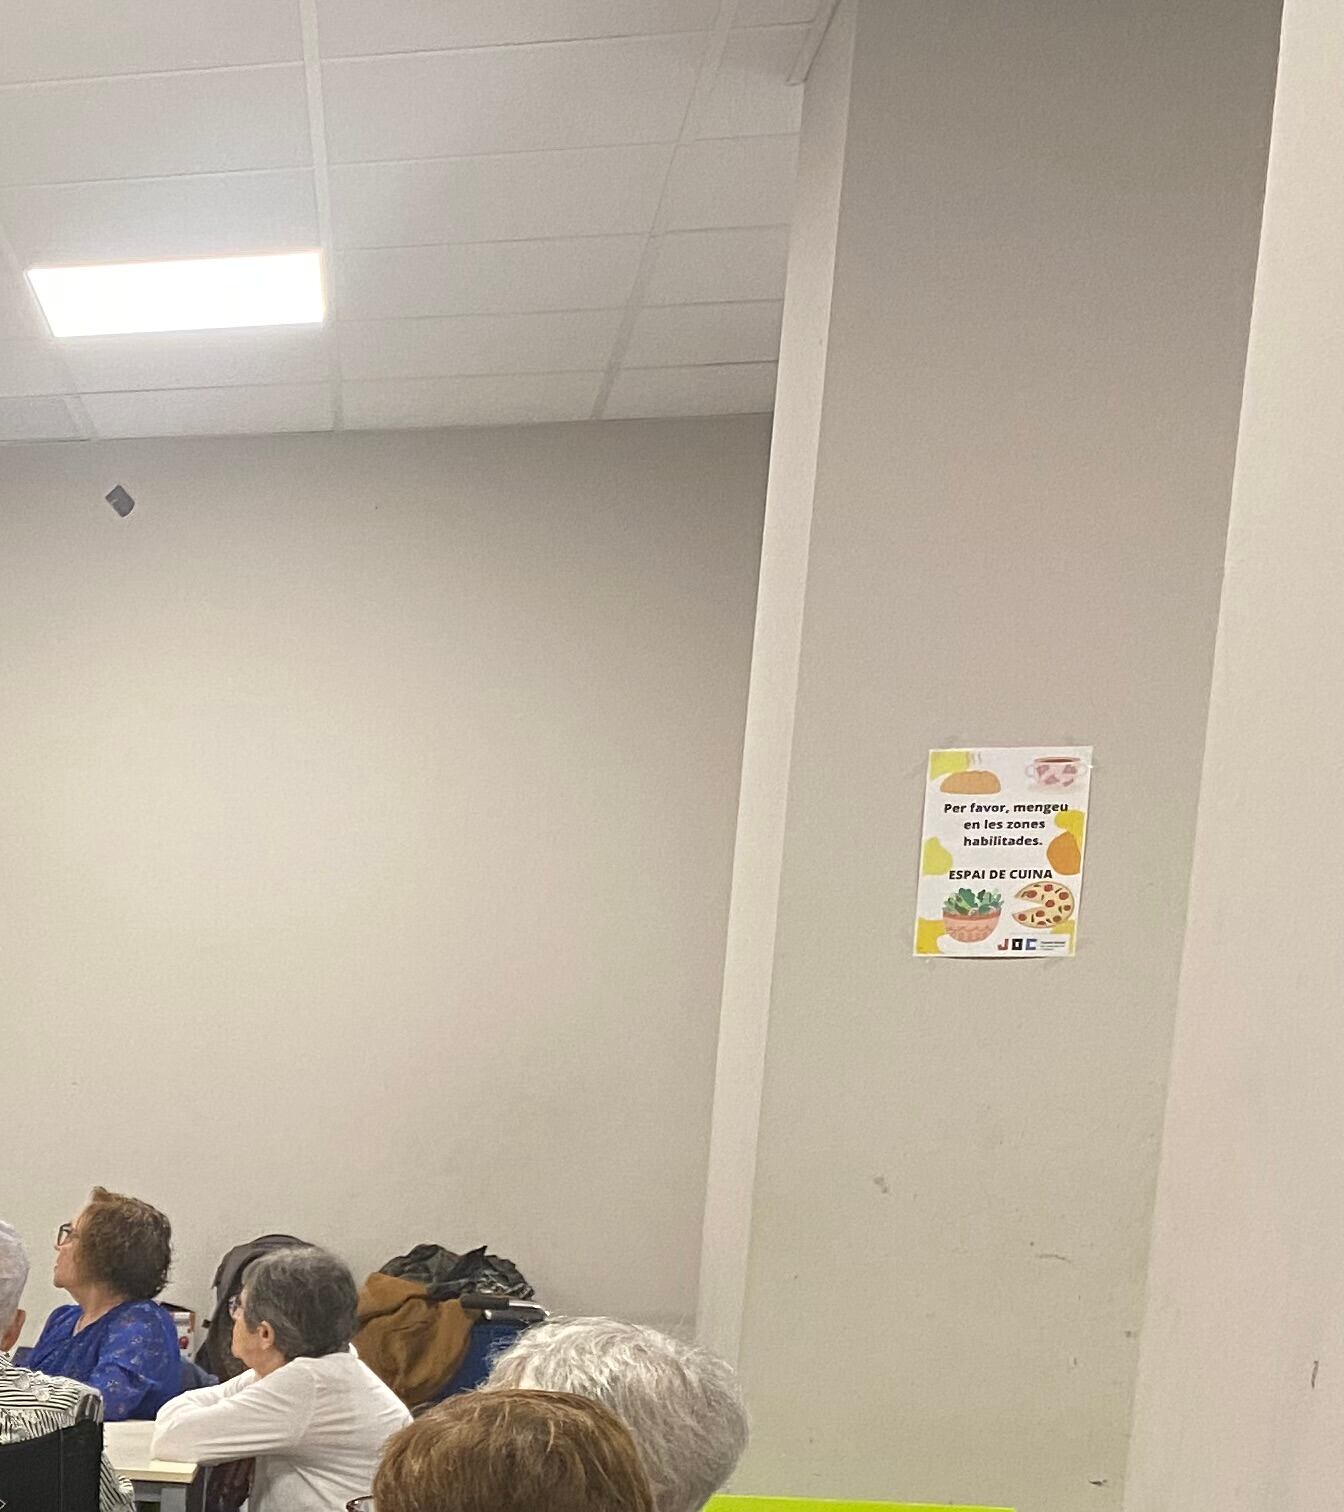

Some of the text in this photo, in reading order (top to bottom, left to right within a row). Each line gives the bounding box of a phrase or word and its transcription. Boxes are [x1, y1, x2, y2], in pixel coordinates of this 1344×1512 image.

[944, 803, 1069, 815] Per favor, mengeu
[963, 819, 1046, 830] en les zones
[963, 836, 1043, 846] habilitades.
[949, 869, 1053, 880] ESPAI DE CUINA
[997, 938, 1037, 951] JOC
